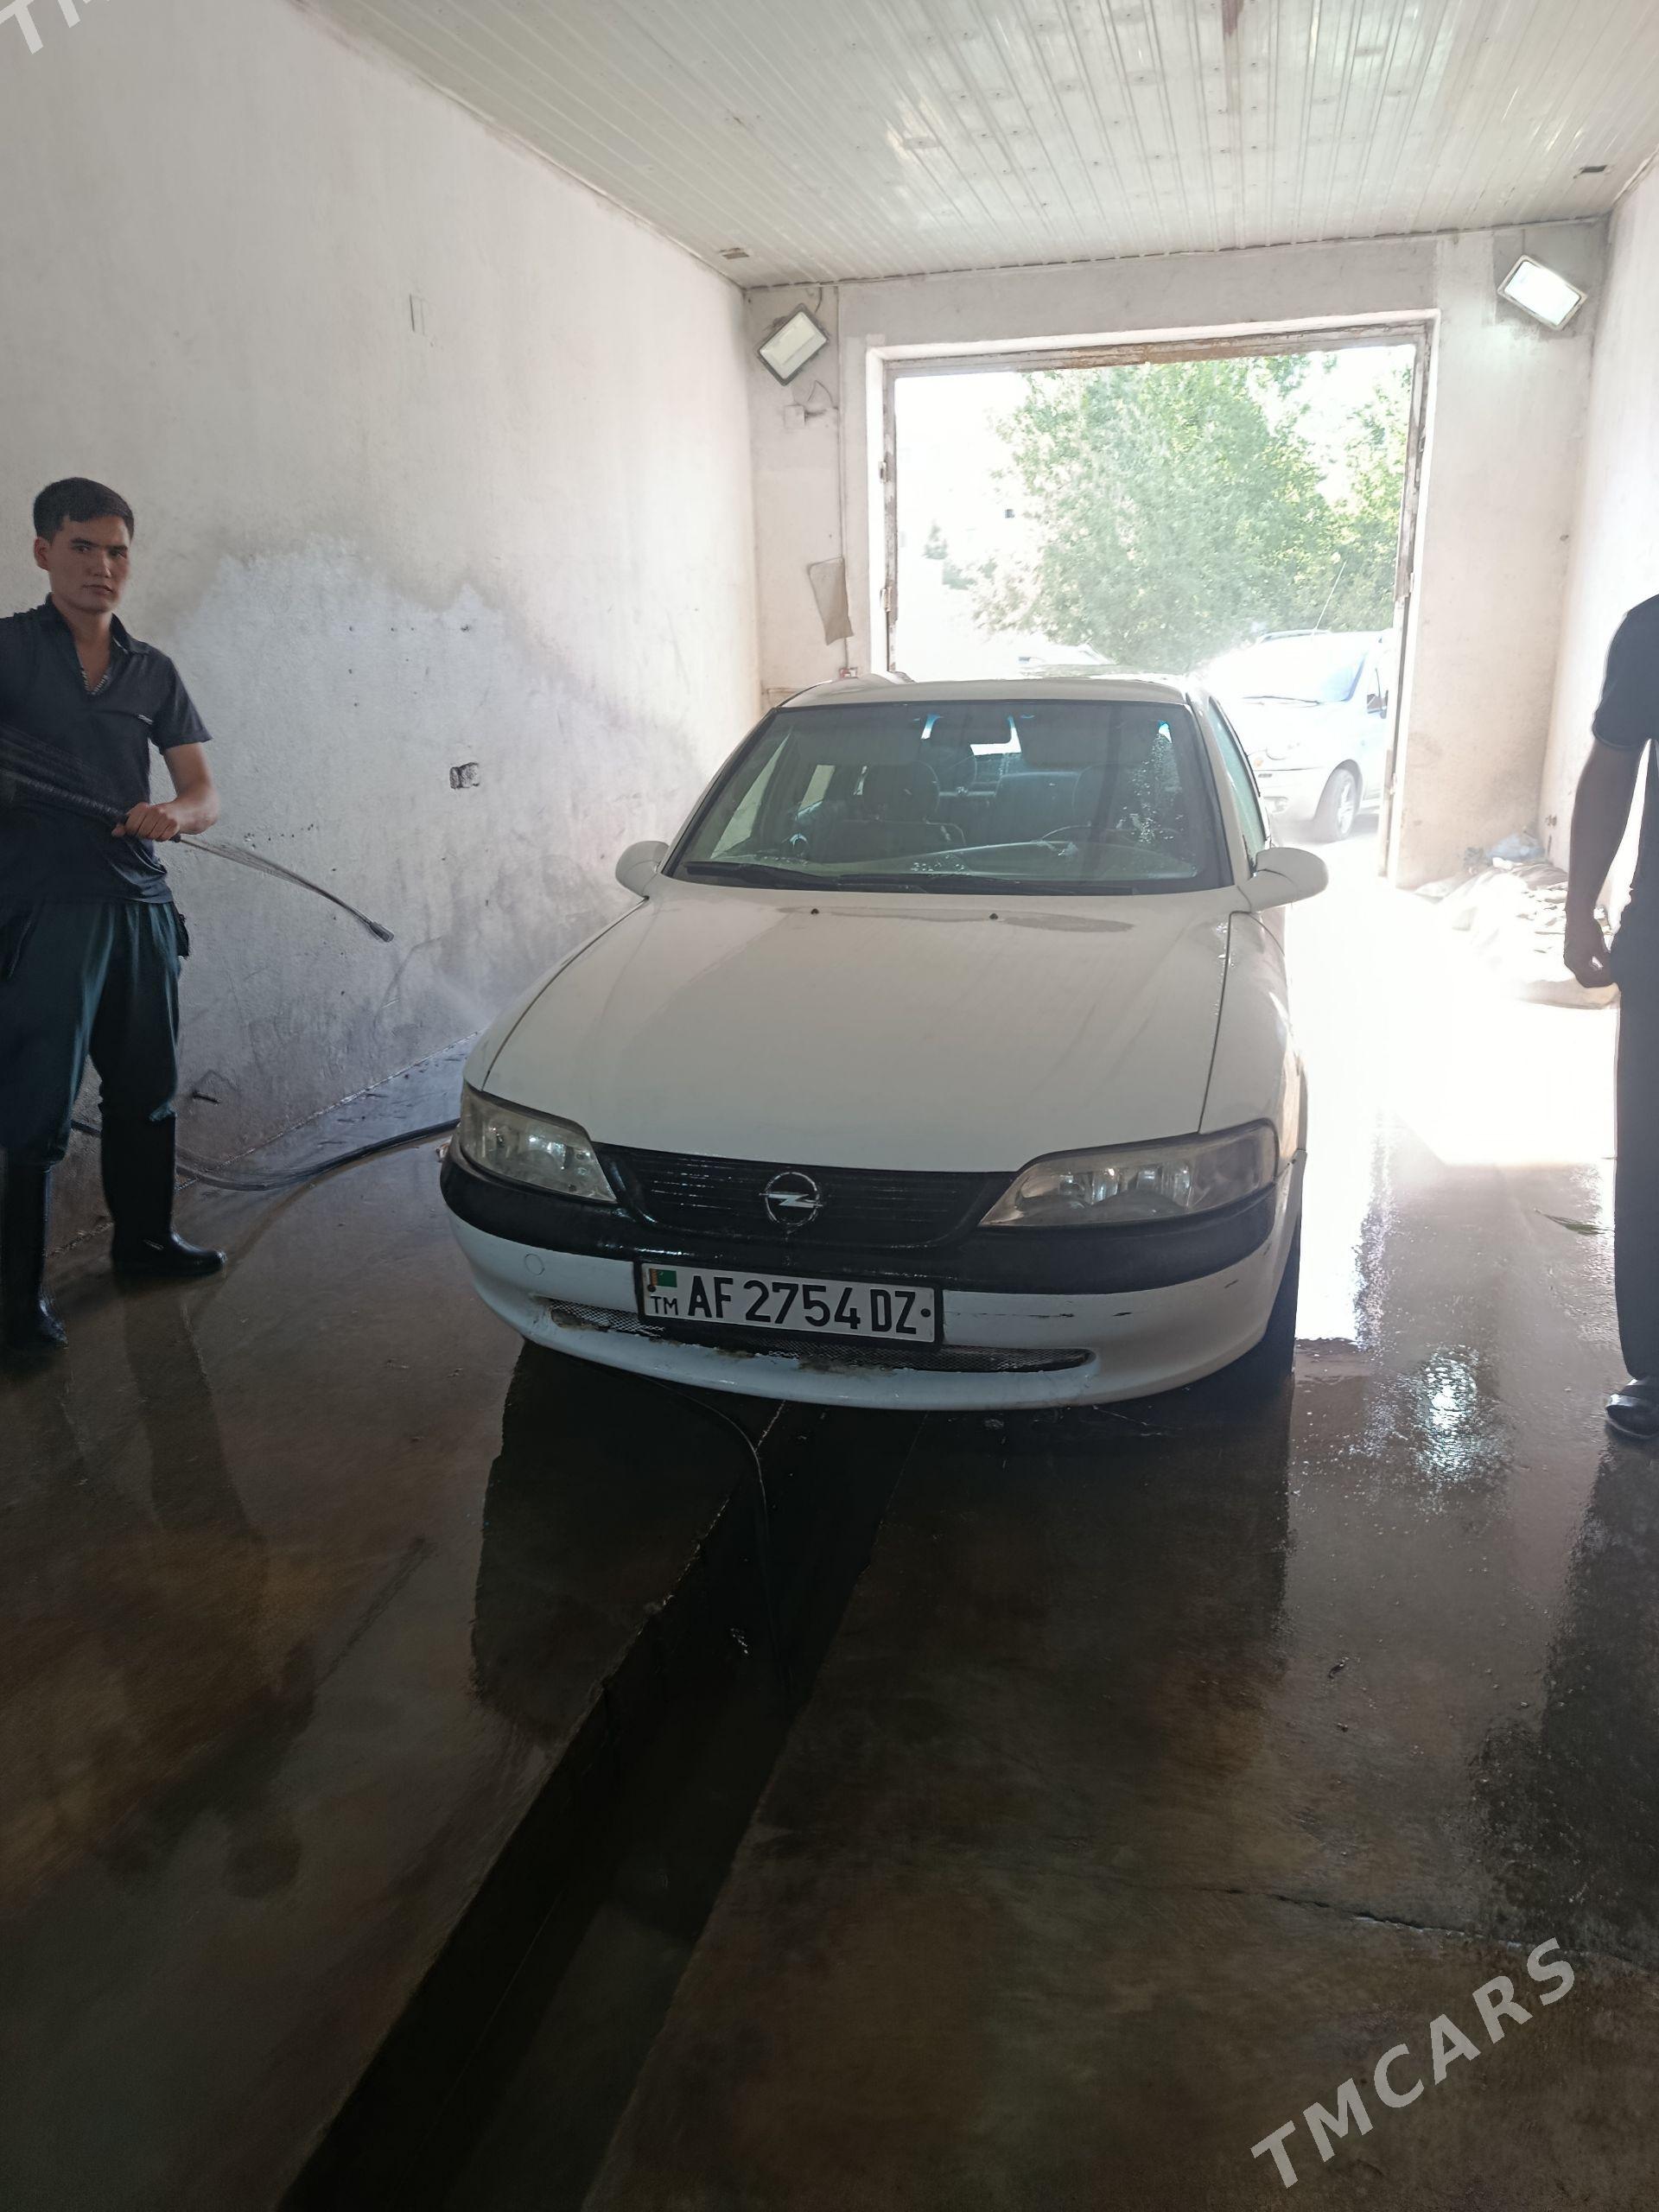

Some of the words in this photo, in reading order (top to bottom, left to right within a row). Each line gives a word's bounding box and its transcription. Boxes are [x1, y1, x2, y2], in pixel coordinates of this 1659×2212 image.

[650, 1295, 678, 1315] TM
[688, 1275, 734, 1318] AF
[743, 1280, 861, 1329] 2754
[870, 1288, 917, 1334] DZ
